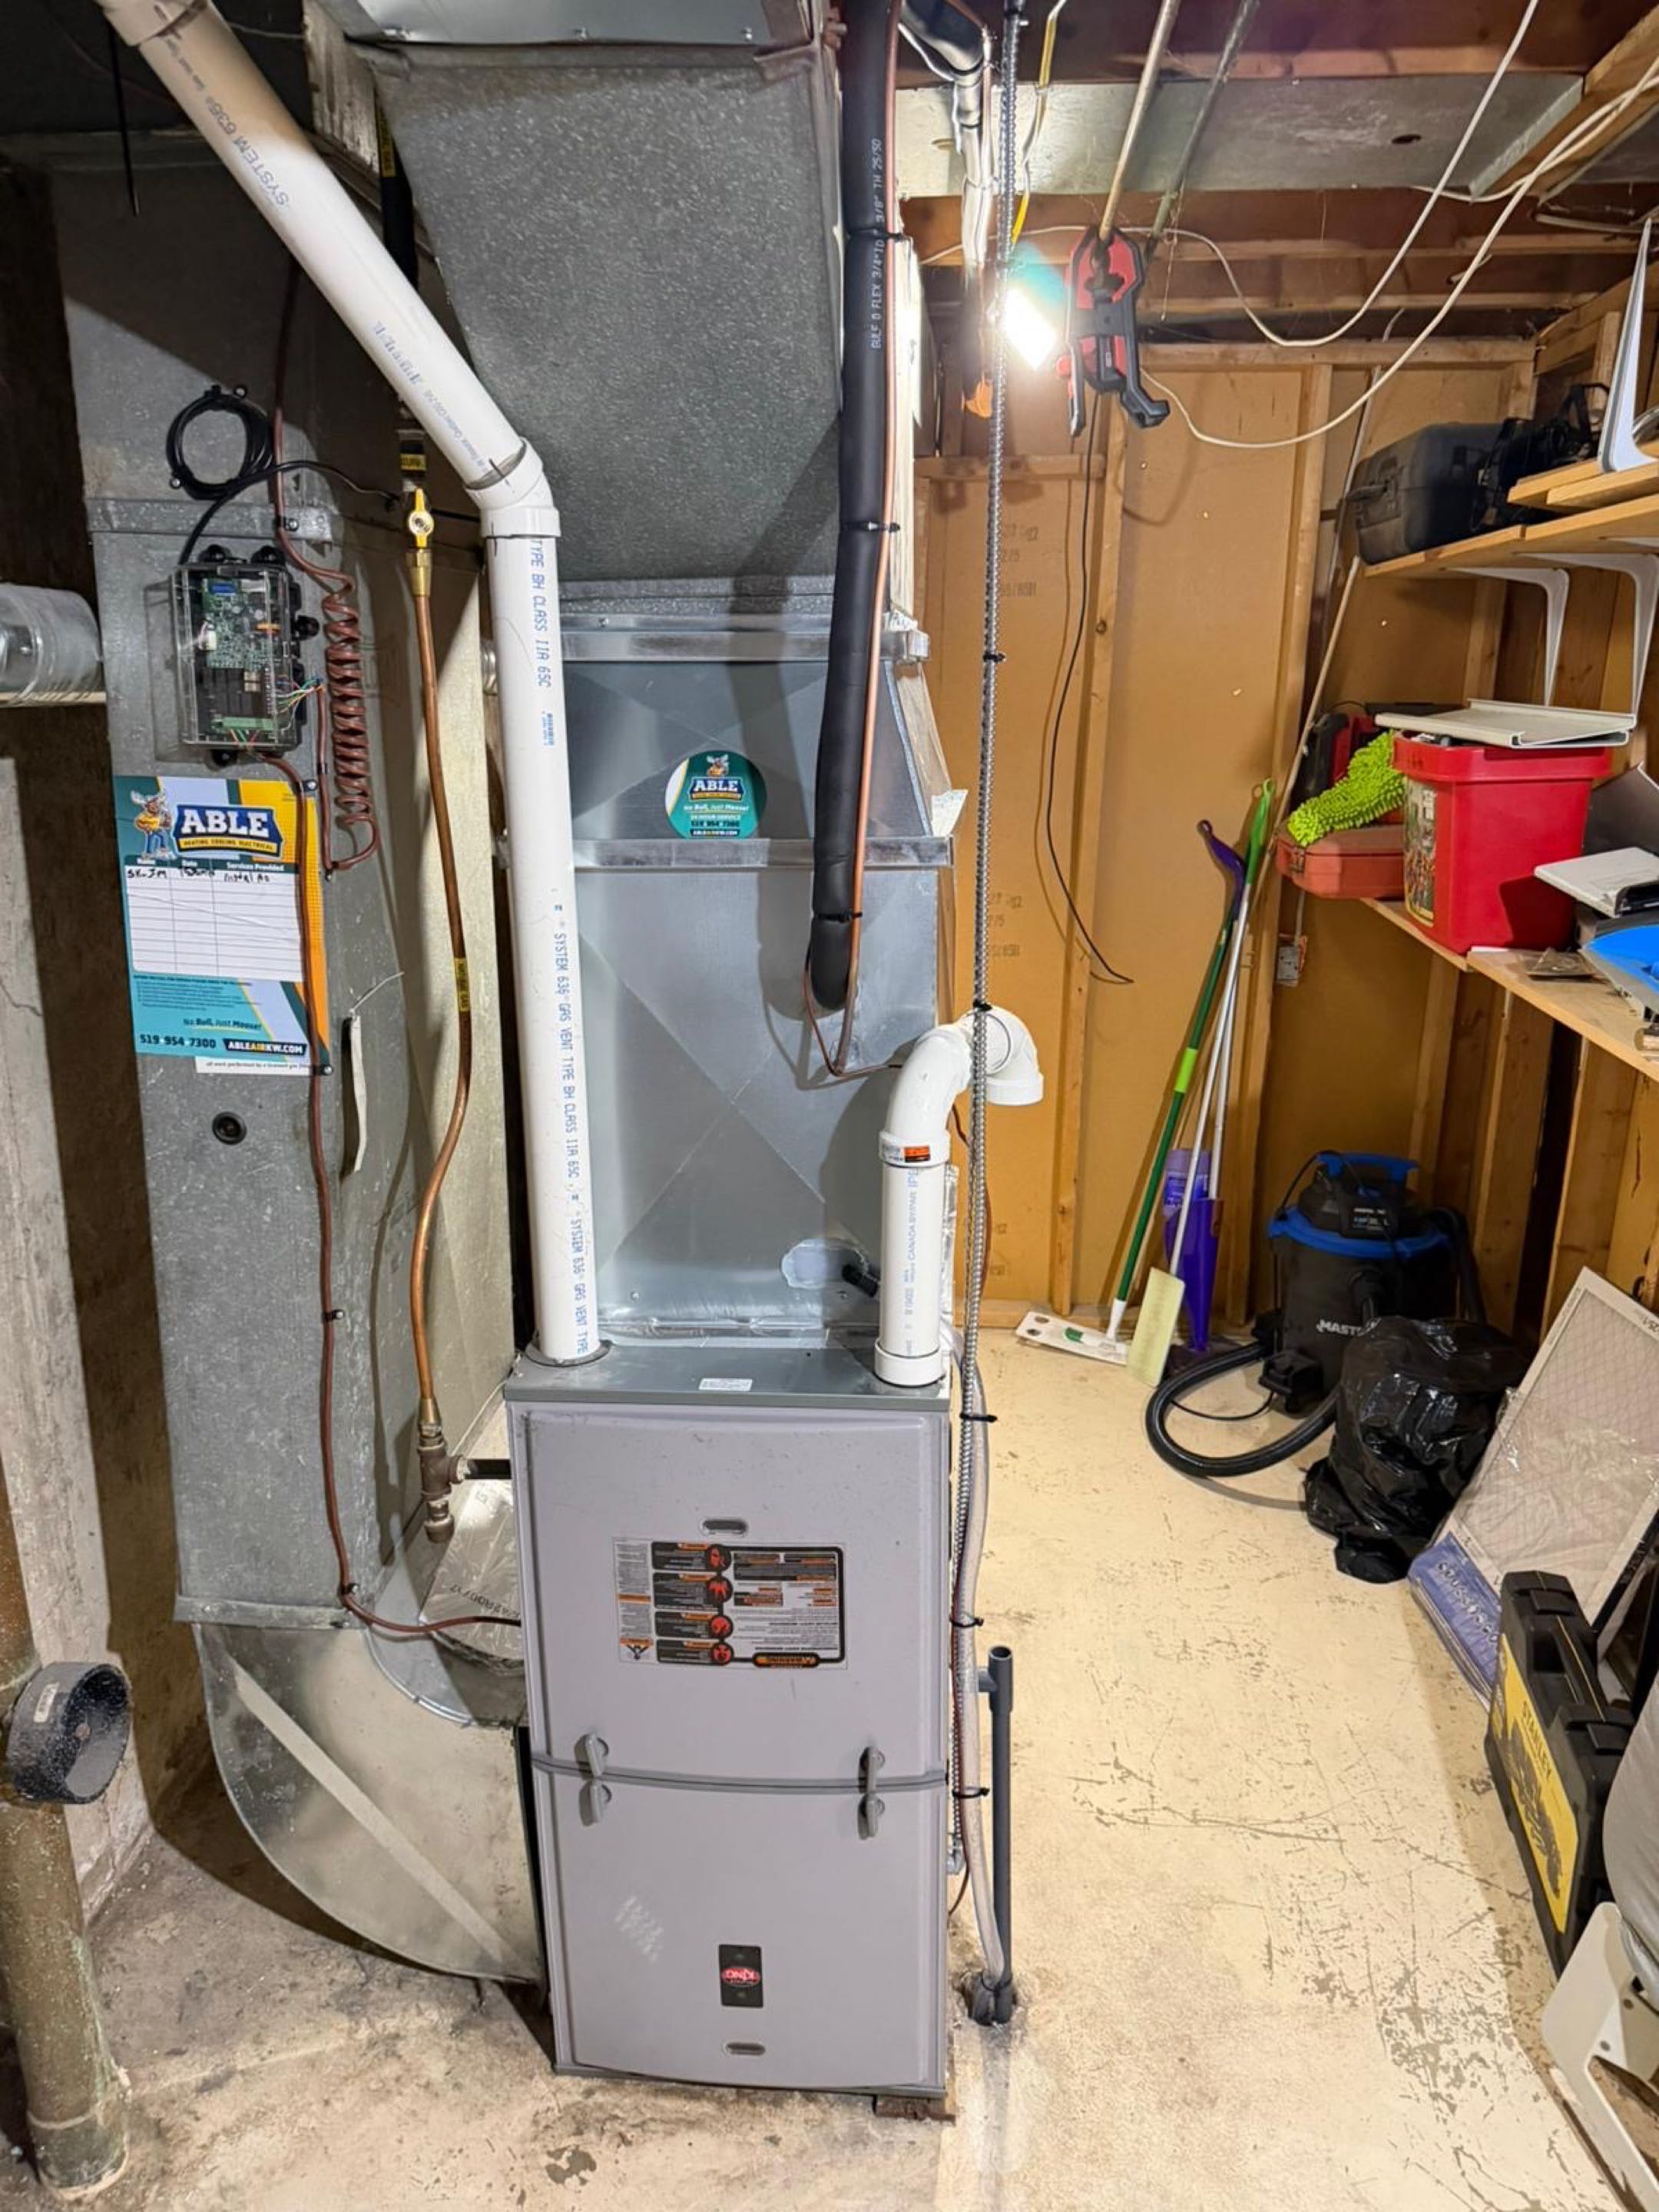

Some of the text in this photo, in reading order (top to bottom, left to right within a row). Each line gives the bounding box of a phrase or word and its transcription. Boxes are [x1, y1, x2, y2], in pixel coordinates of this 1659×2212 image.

[233, 137, 289, 206] SYSTEM
[873, 284, 882, 309] FLEX
[531, 540, 545, 568] TYPE
[533, 596, 548, 631] CLASS
[694, 780, 738, 792] ABLE
[181, 808, 269, 838] ABLE
[554, 932, 568, 971] SYSTEM
[558, 1003, 571, 1022] GAS
[140, 1034, 217, 1048] 519 954 7300
[559, 1027, 574, 1051] VENT
[561, 1057, 575, 1081] TYPE
[564, 1104, 578, 1134] CLASS
[908, 1224, 917, 1260] CANADA
[575, 1283, 586, 1301] GAS
[575, 1306, 588, 1327] VENT
[578, 1331, 589, 1354] TYPE
